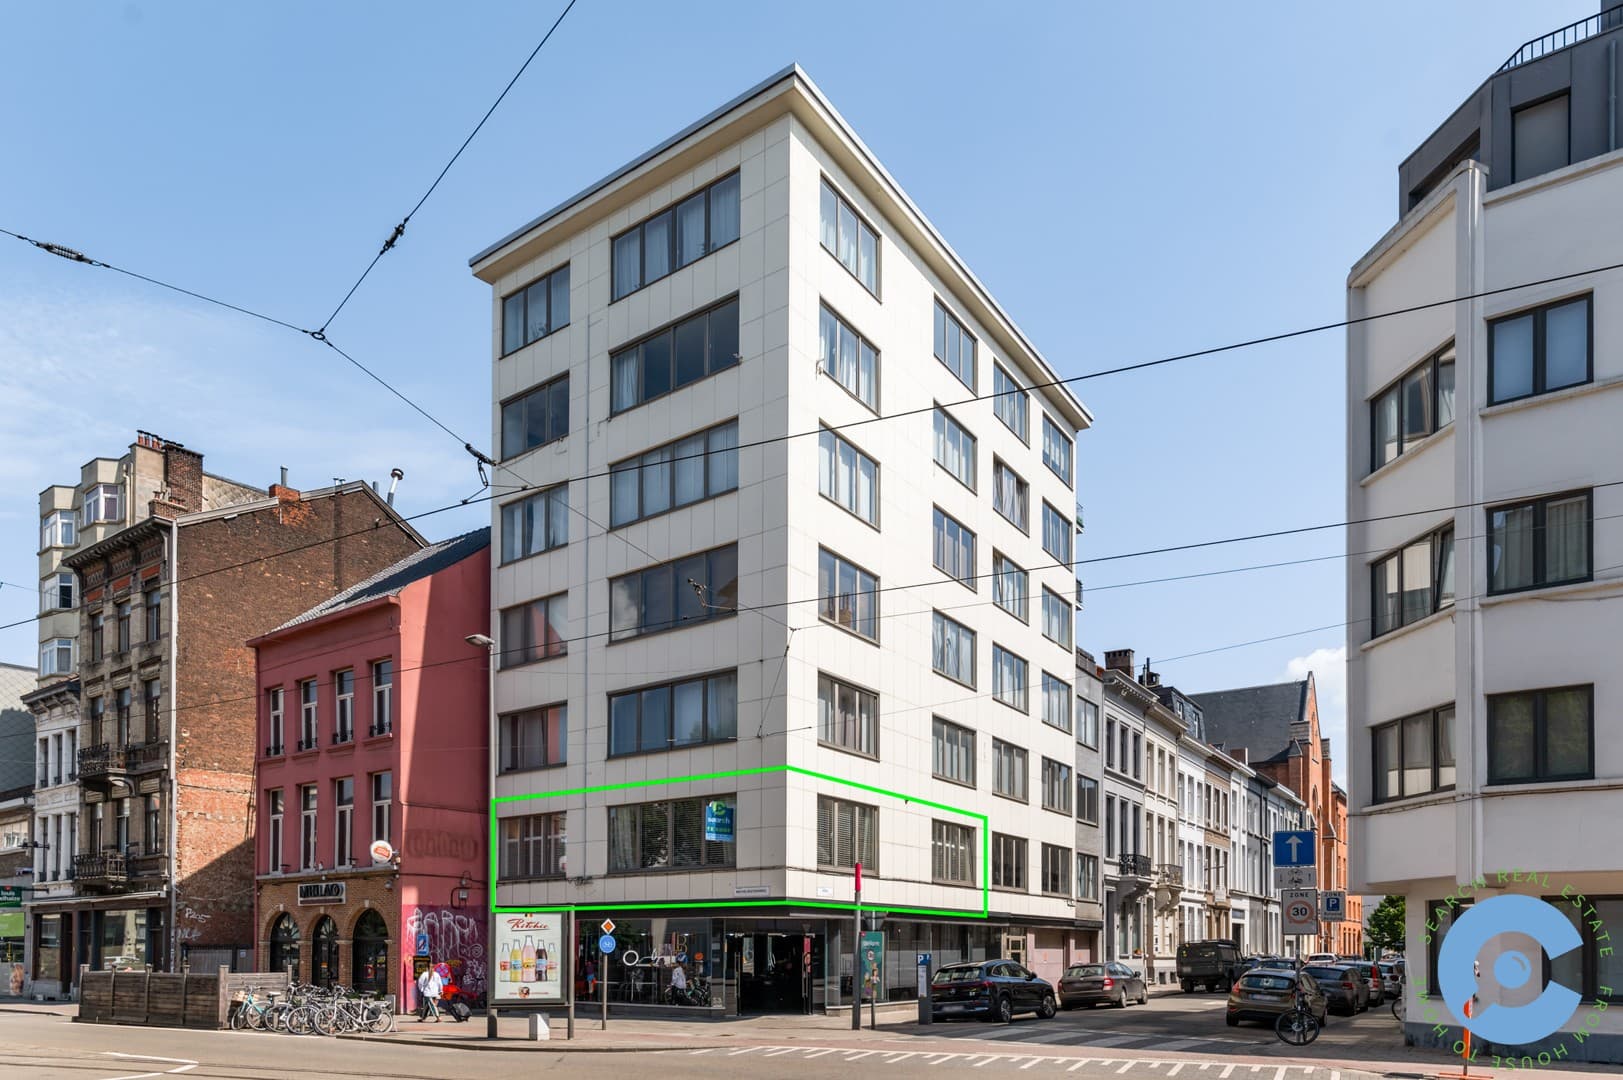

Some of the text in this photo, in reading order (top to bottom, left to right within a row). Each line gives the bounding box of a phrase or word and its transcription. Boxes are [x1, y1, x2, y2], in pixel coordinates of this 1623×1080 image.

[1330, 899, 1338, 908] P
[1292, 907, 1308, 917] 30
[917, 955, 924, 965] P
